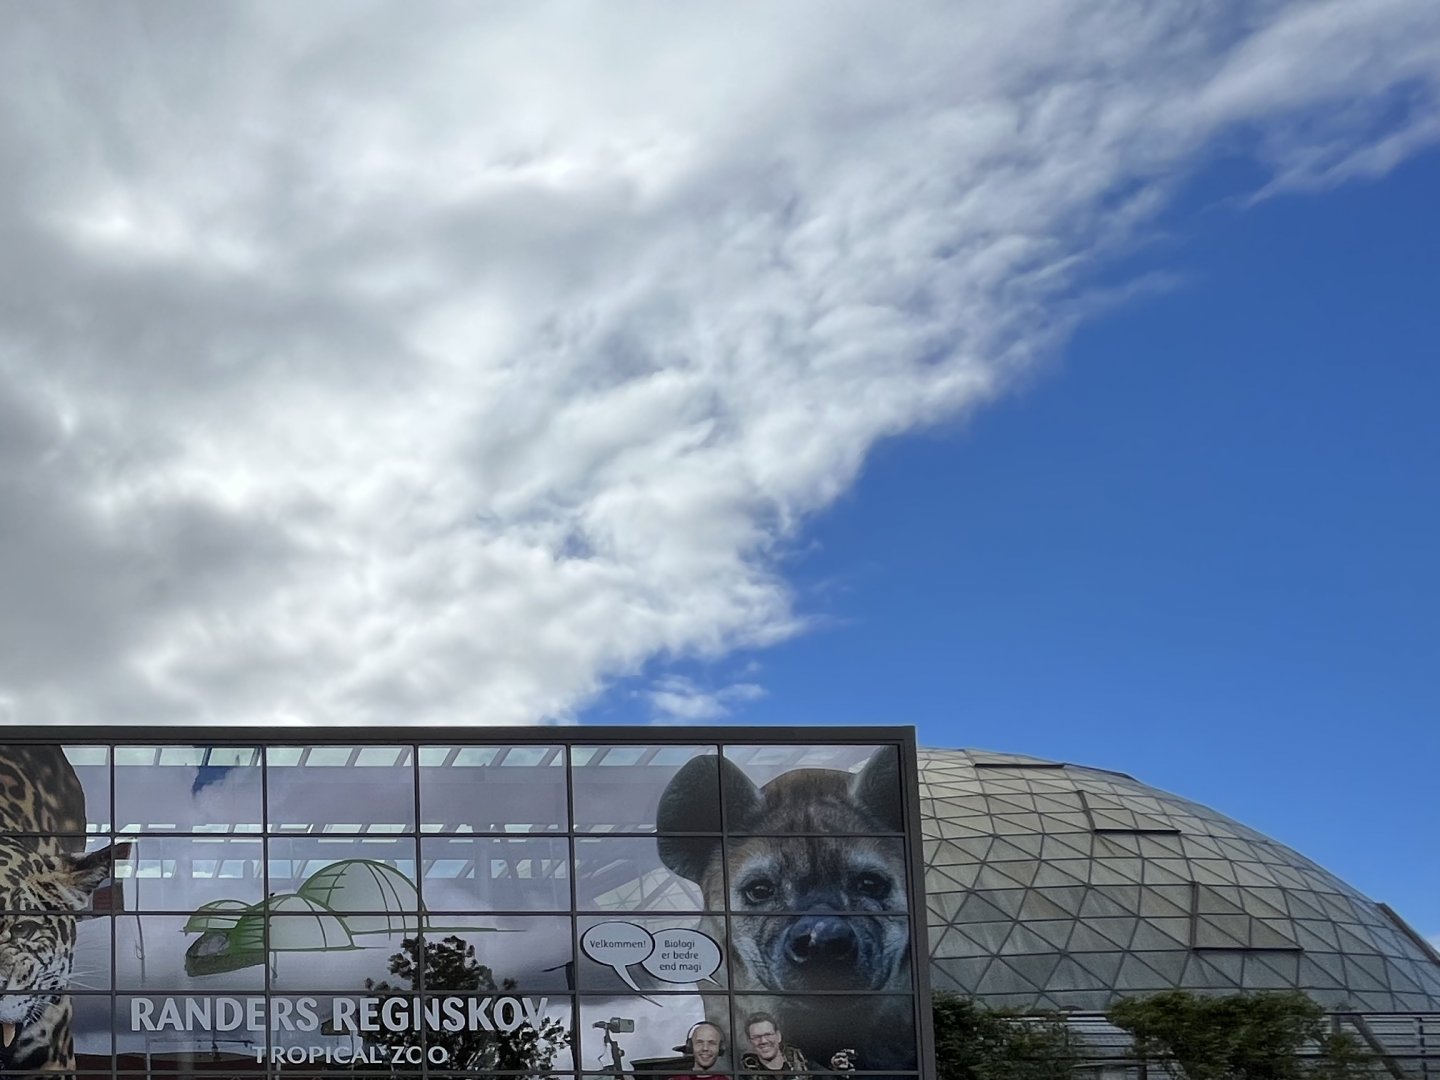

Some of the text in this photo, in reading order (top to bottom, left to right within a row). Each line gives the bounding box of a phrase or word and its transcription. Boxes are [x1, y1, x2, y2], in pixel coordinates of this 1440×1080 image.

[589, 939, 647, 949] Velkommen!
[664, 939, 695, 950] Biologi
[661, 950, 699, 960] er bedre
[659, 962, 702, 973] end magi
[130, 996, 548, 1032] RANDERS REGNSKOV
[252, 1045, 448, 1064] TROPICAL ZOO
